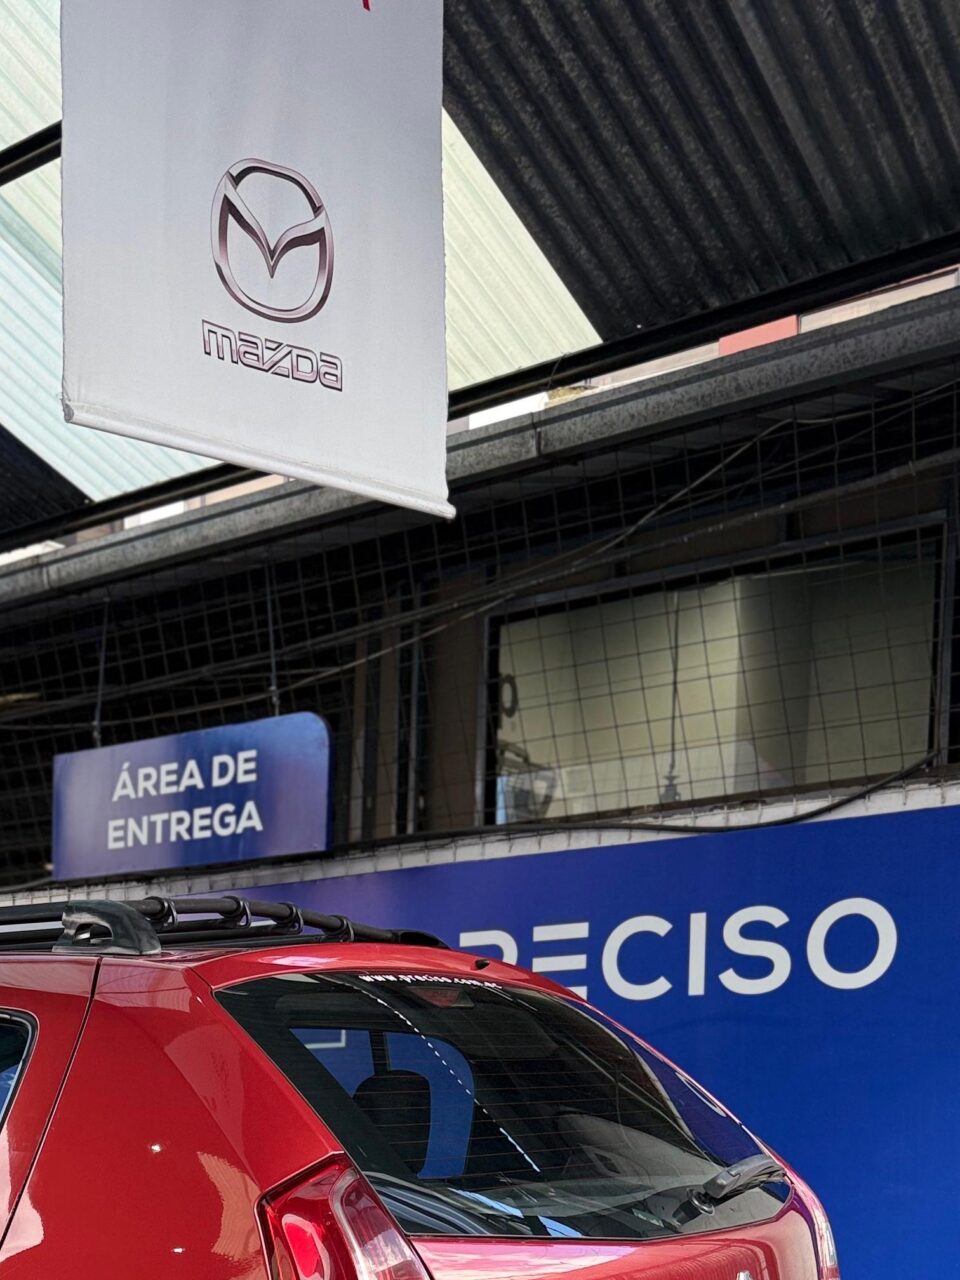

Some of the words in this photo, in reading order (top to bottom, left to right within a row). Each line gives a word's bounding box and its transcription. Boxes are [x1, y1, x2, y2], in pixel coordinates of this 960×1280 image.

[112, 758, 205, 802] ÁREA
[211, 749, 258, 788] DE
[107, 800, 263, 849] ENTREGA
